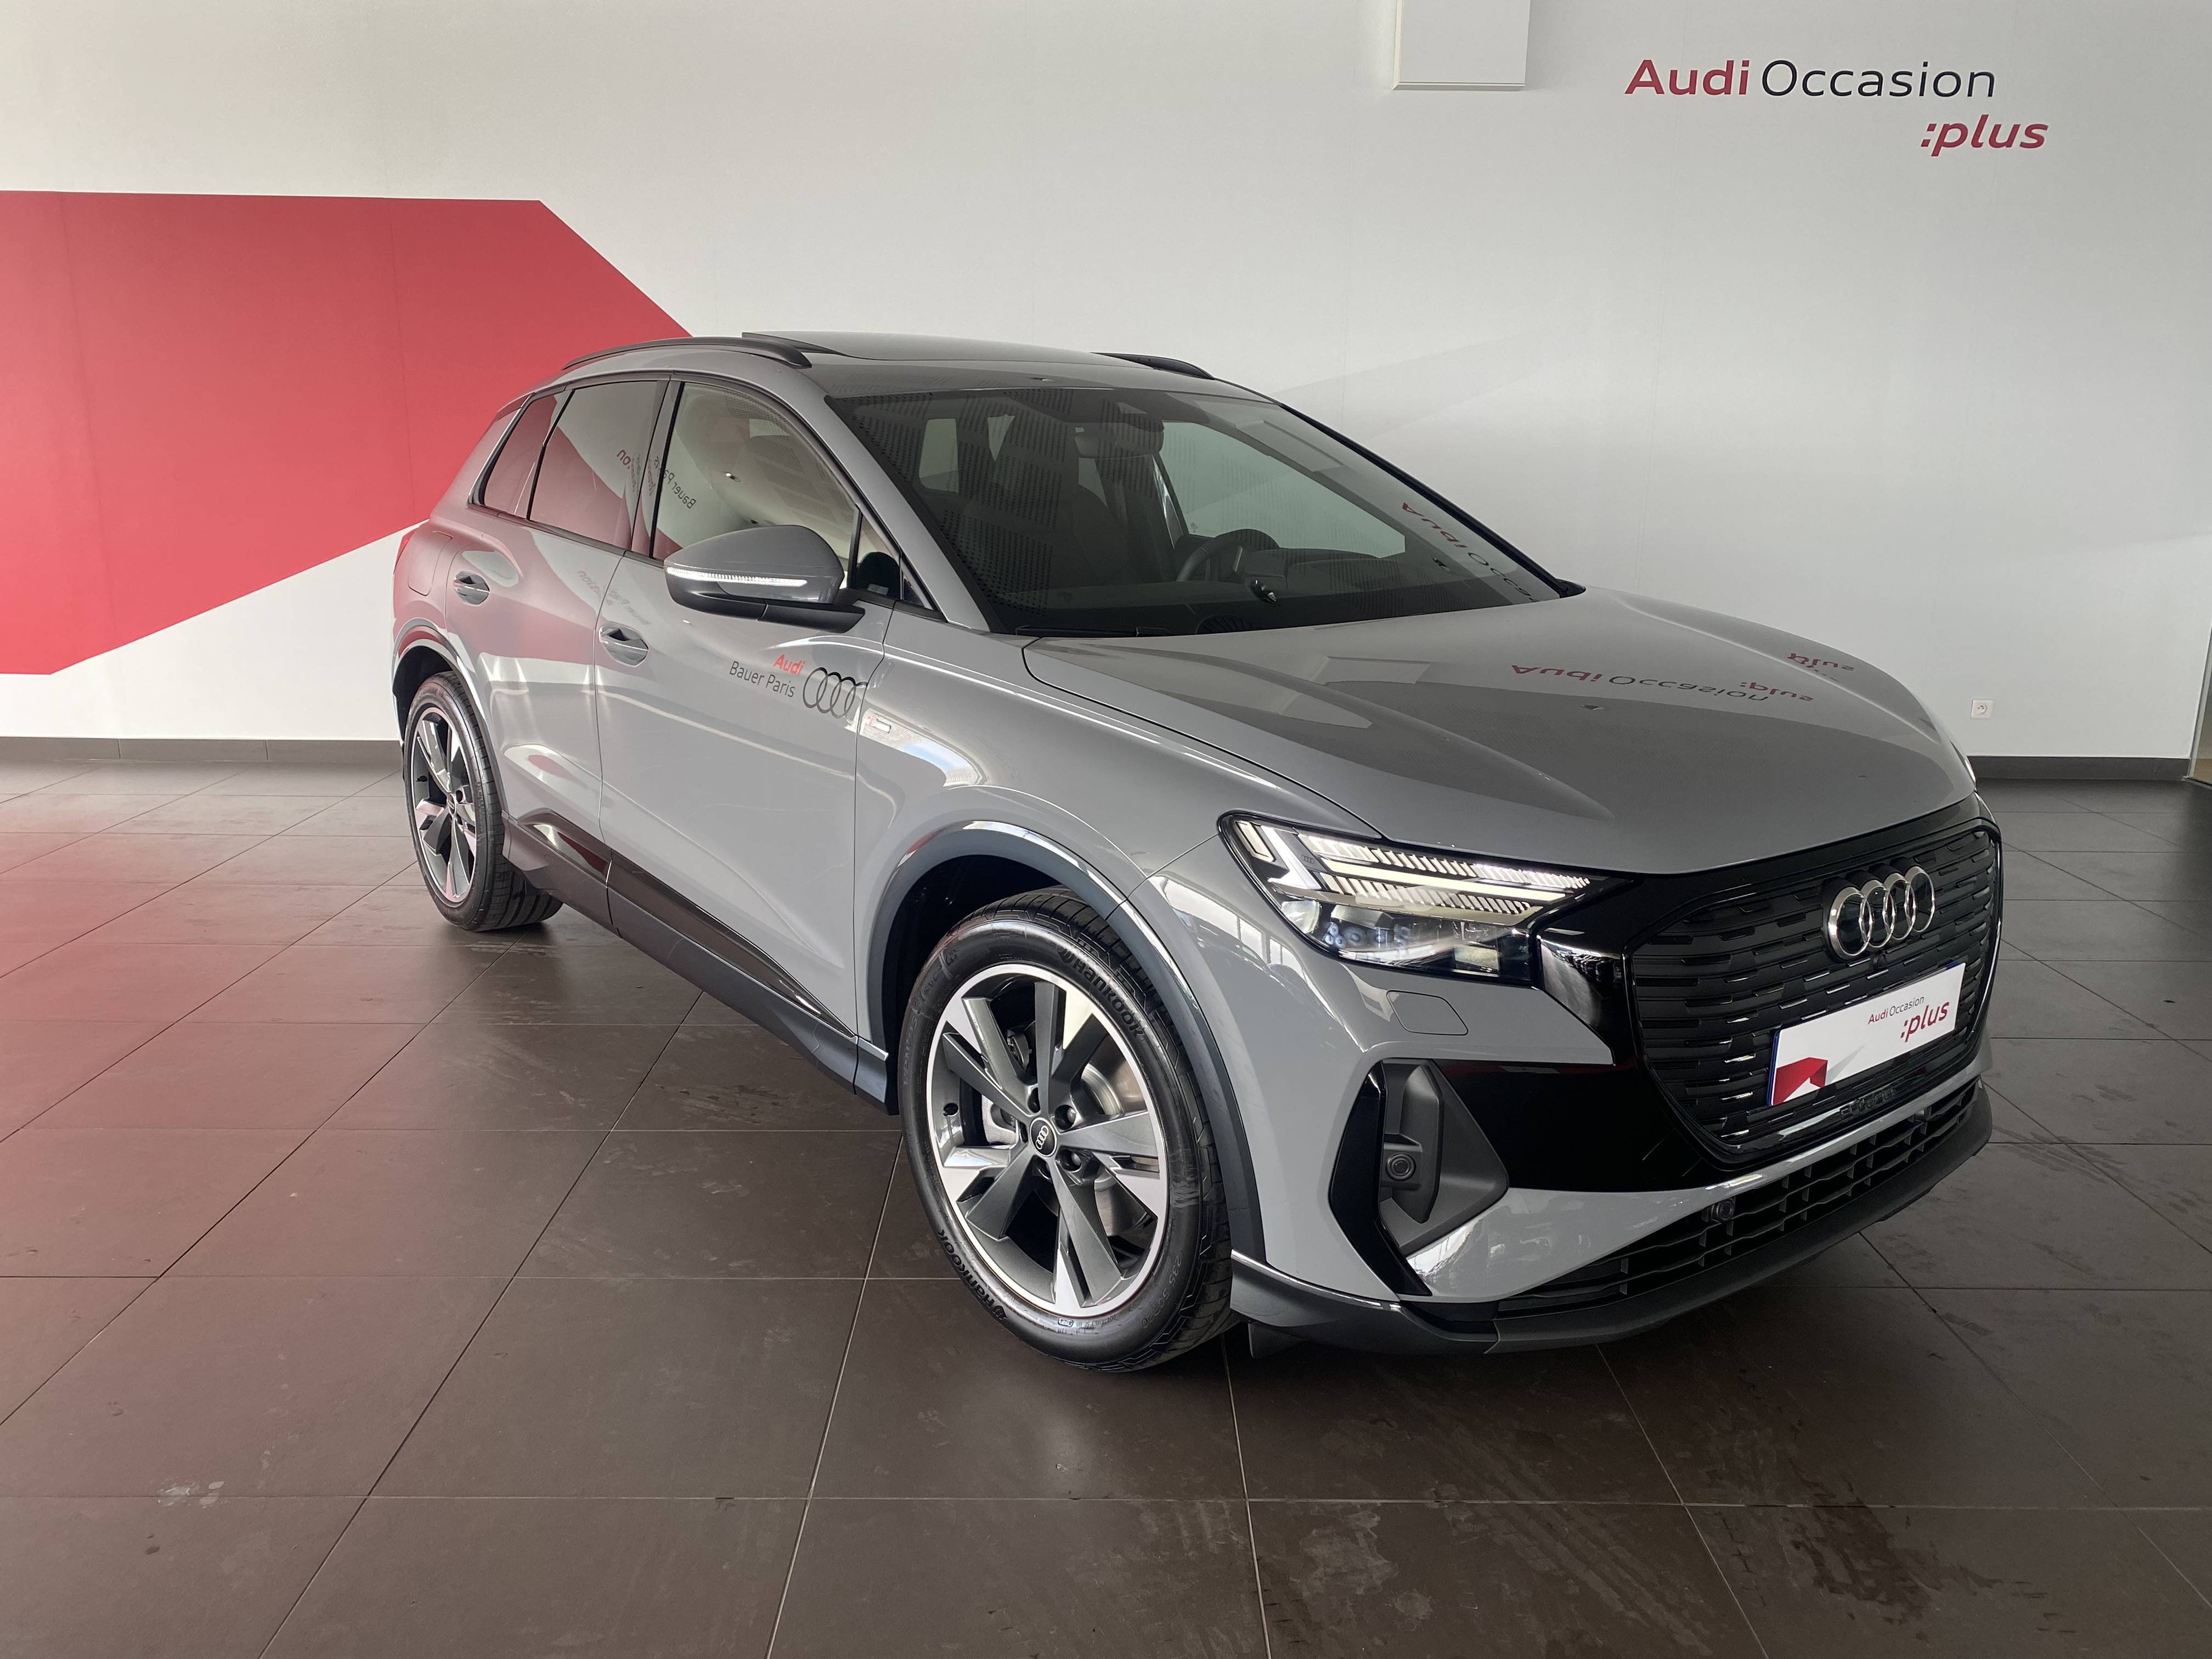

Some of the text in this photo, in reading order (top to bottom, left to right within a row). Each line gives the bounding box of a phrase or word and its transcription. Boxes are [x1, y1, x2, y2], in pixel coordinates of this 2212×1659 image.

[1625, 59, 1995, 98] Audi Occasion
[1920, 114, 2049, 157] :plus
[729, 661, 795, 698] Bauer Paris
[772, 653, 805, 676] Audi
[1073, 958, 1144, 1038] Hankook
[1867, 996, 1925, 1025] Audi Occasion
[1900, 1002, 1950, 1043] :plus
